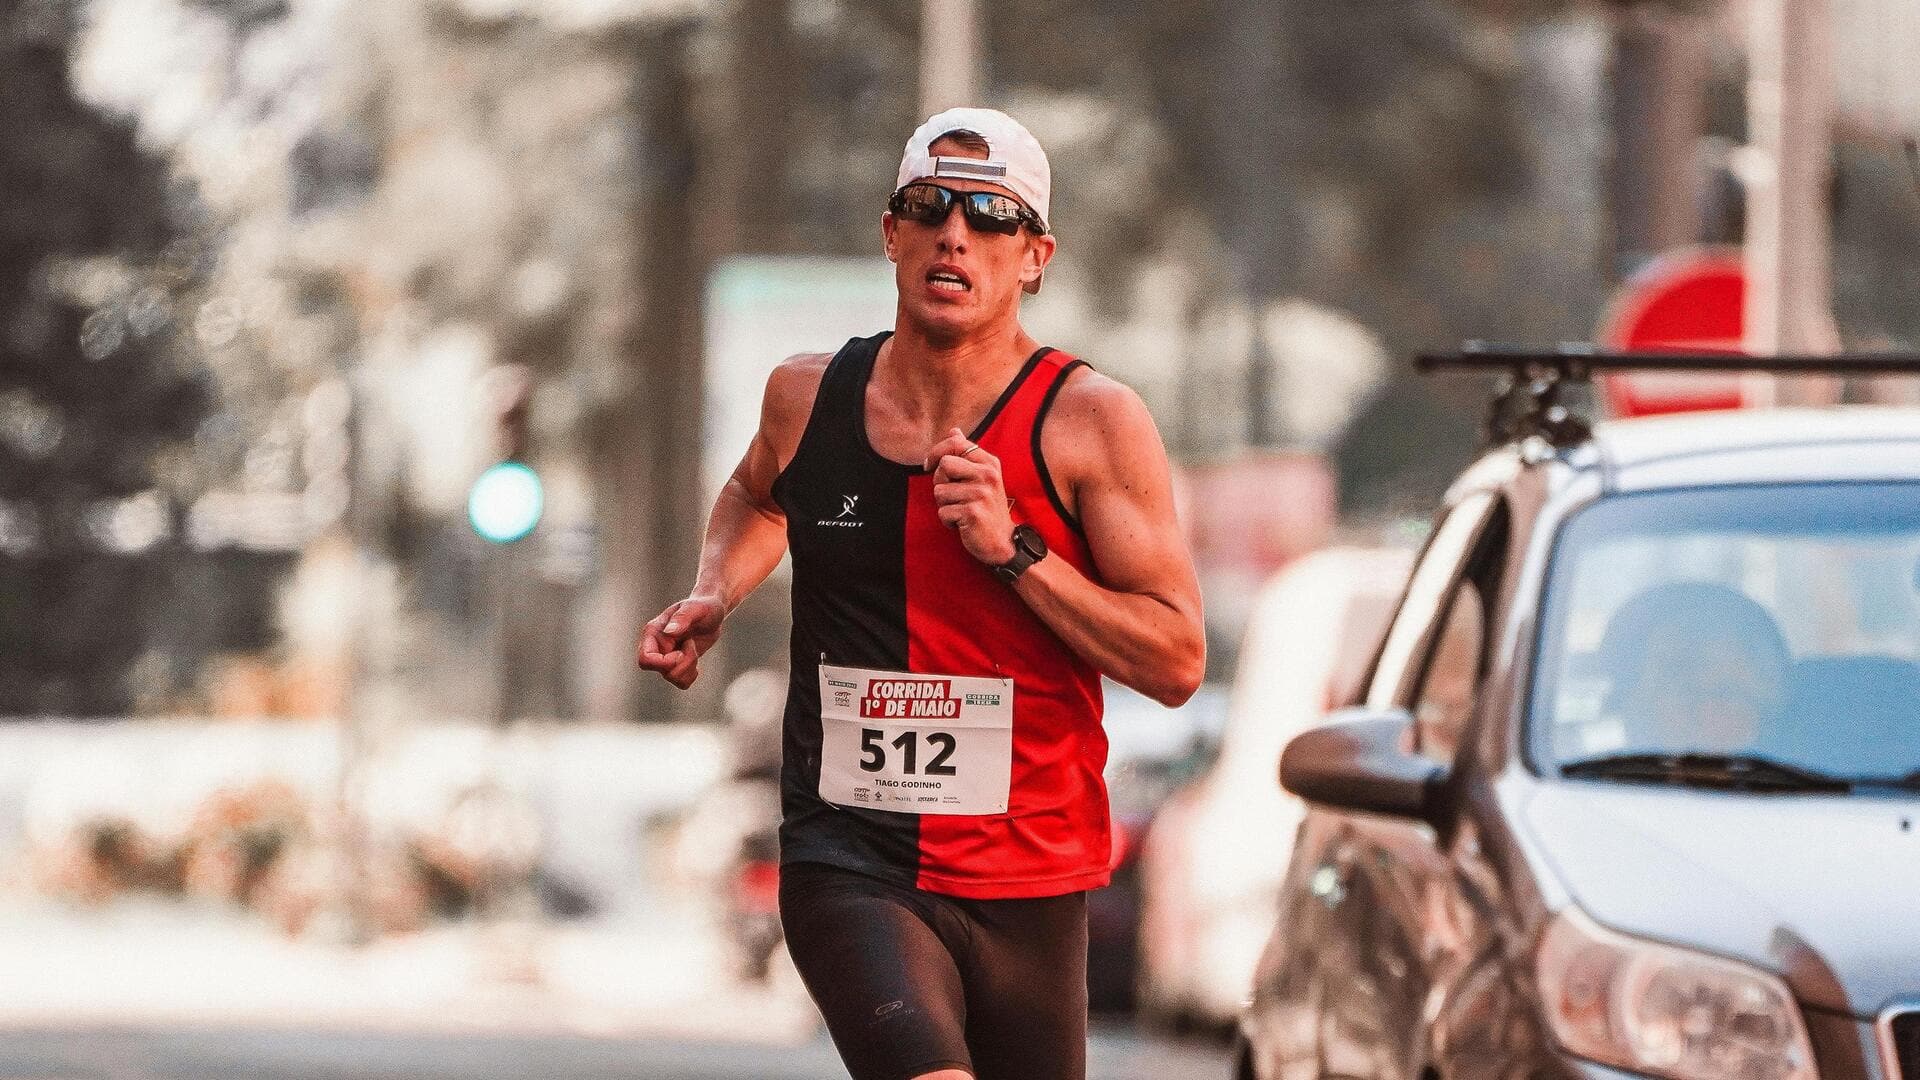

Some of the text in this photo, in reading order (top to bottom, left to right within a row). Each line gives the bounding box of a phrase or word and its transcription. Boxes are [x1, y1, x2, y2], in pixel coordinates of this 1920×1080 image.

[872, 682, 945, 699] CORRIDA
[885, 700, 907, 717] DE
[910, 701, 956, 717] MAIO
[860, 728, 956, 776] 512
[875, 779, 942, 789] TIAGO GODINHO
